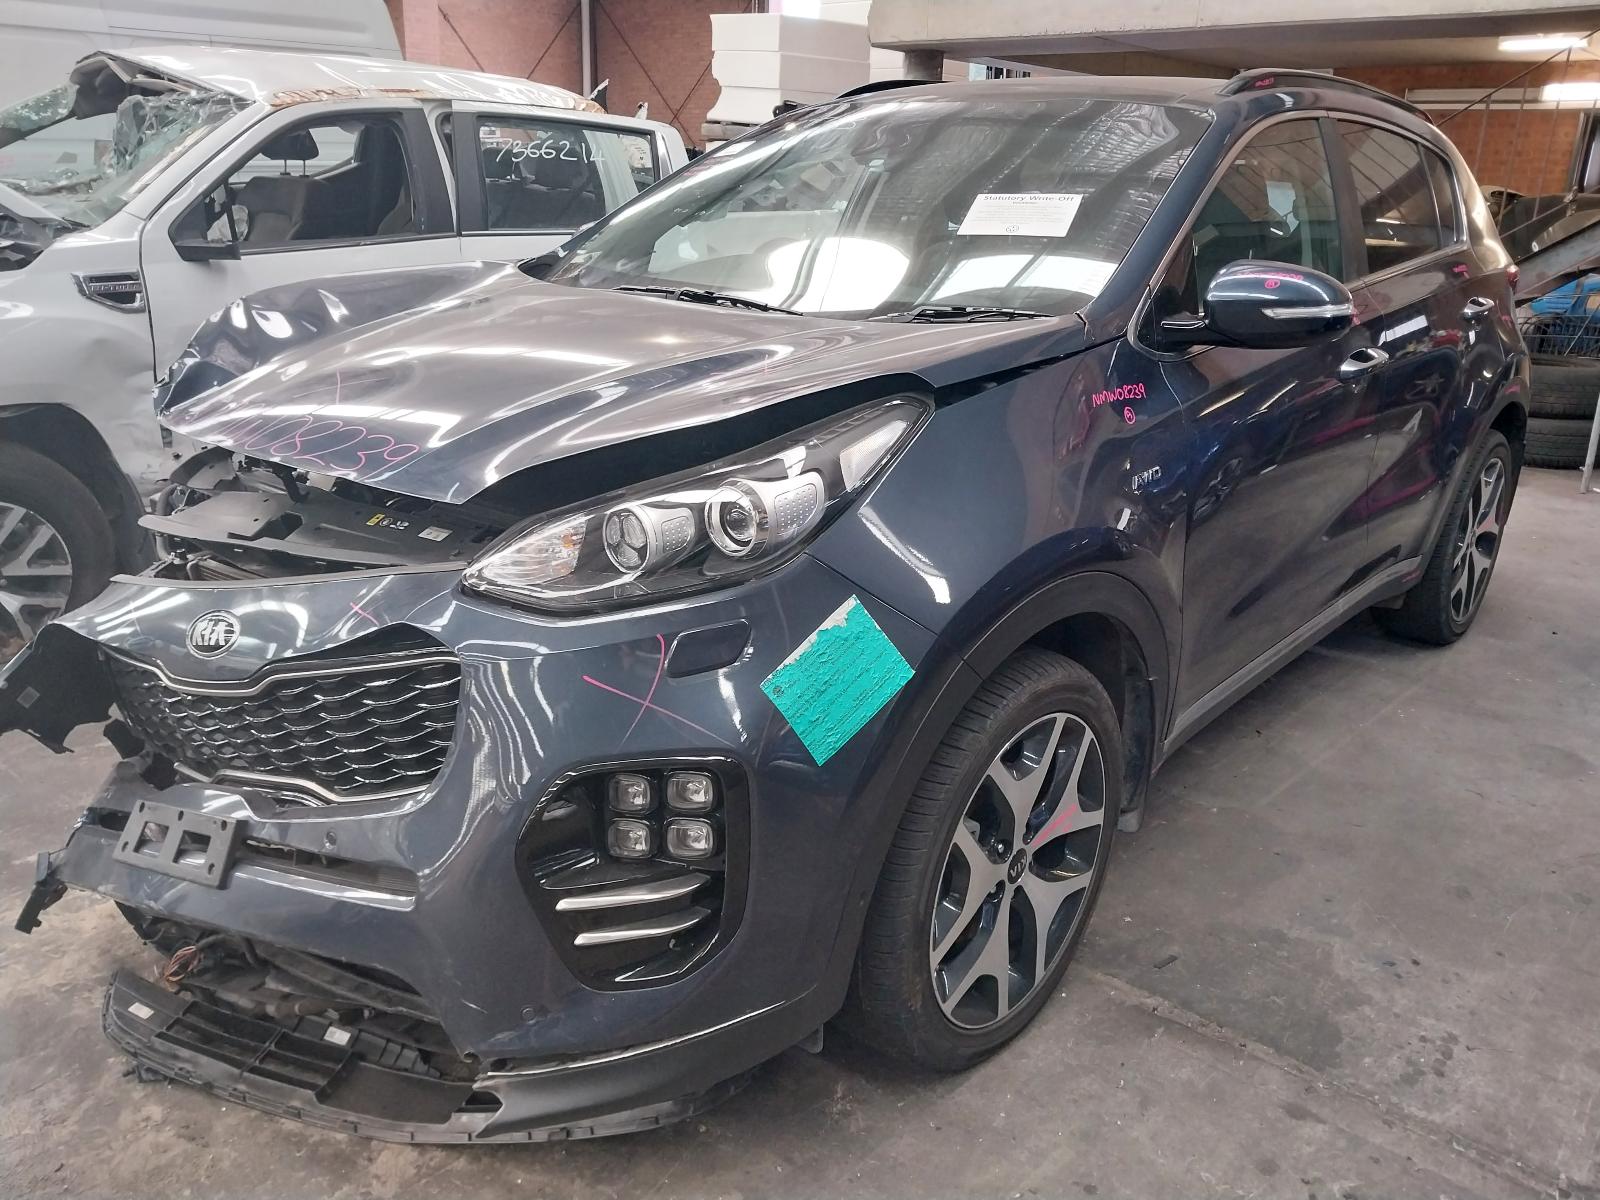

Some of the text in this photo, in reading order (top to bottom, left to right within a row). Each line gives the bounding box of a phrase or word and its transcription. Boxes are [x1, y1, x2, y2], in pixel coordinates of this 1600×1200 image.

[495, 138, 605, 164] 7366214
[983, 194, 1027, 203] Statutory
[1029, 194, 1075, 202] Write-Off
[1091, 382, 1147, 408] NMW08239
[192, 619, 227, 646] KIA
